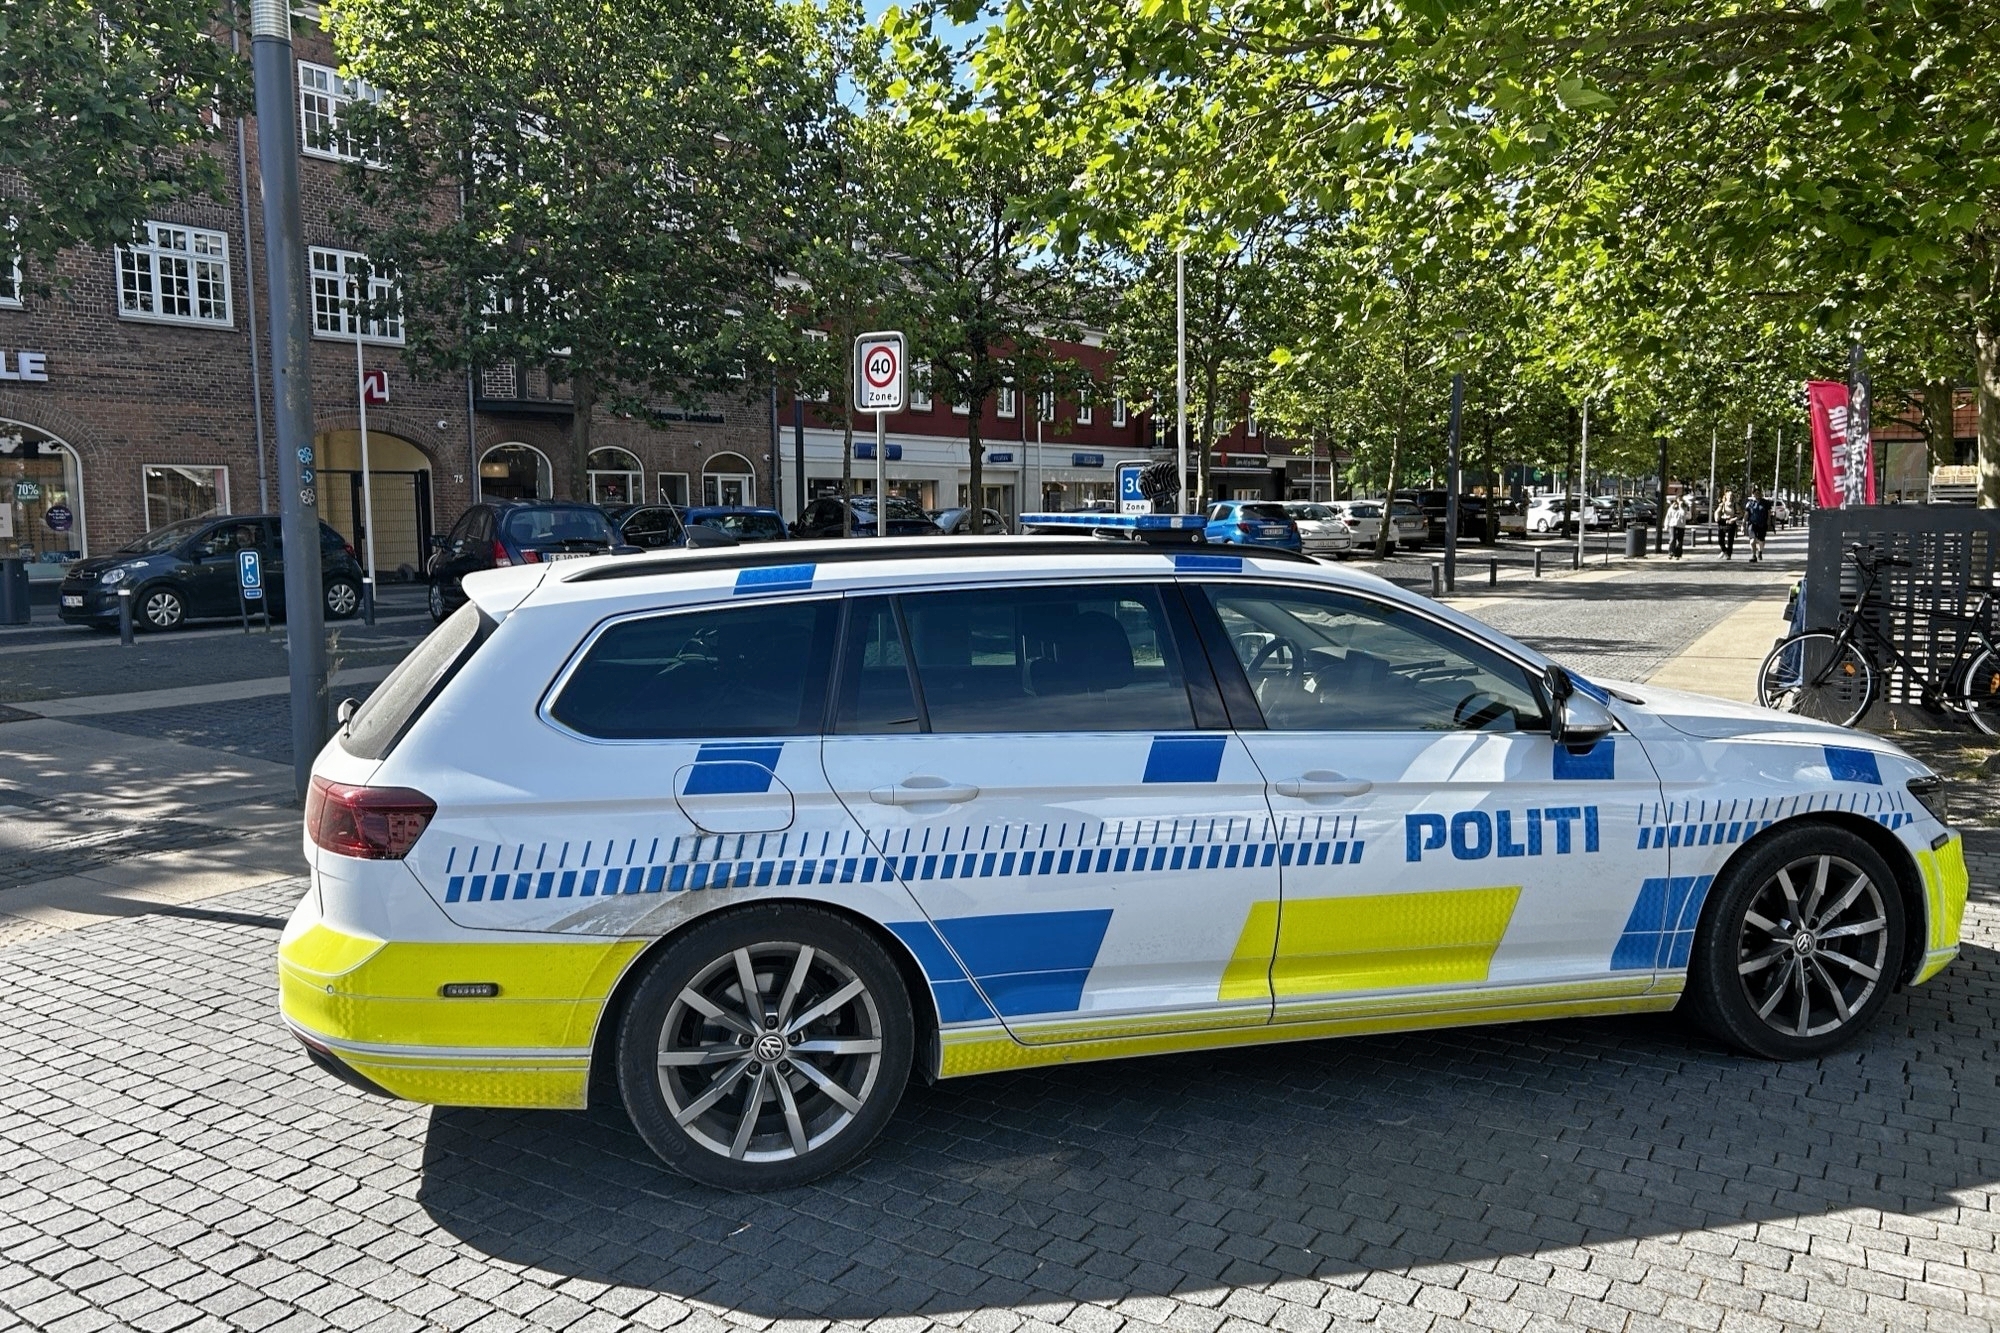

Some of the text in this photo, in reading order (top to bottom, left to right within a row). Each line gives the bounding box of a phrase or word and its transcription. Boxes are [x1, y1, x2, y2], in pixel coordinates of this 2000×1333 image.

[0, 351, 48, 381] LE
[871, 358, 891, 374] 40
[869, 392, 892, 401] Zone
[453, 474, 464, 483] 75
[16, 484, 39, 495] 70%
[245, 555, 255, 570] P
[1405, 806, 1600, 862] POLITI
